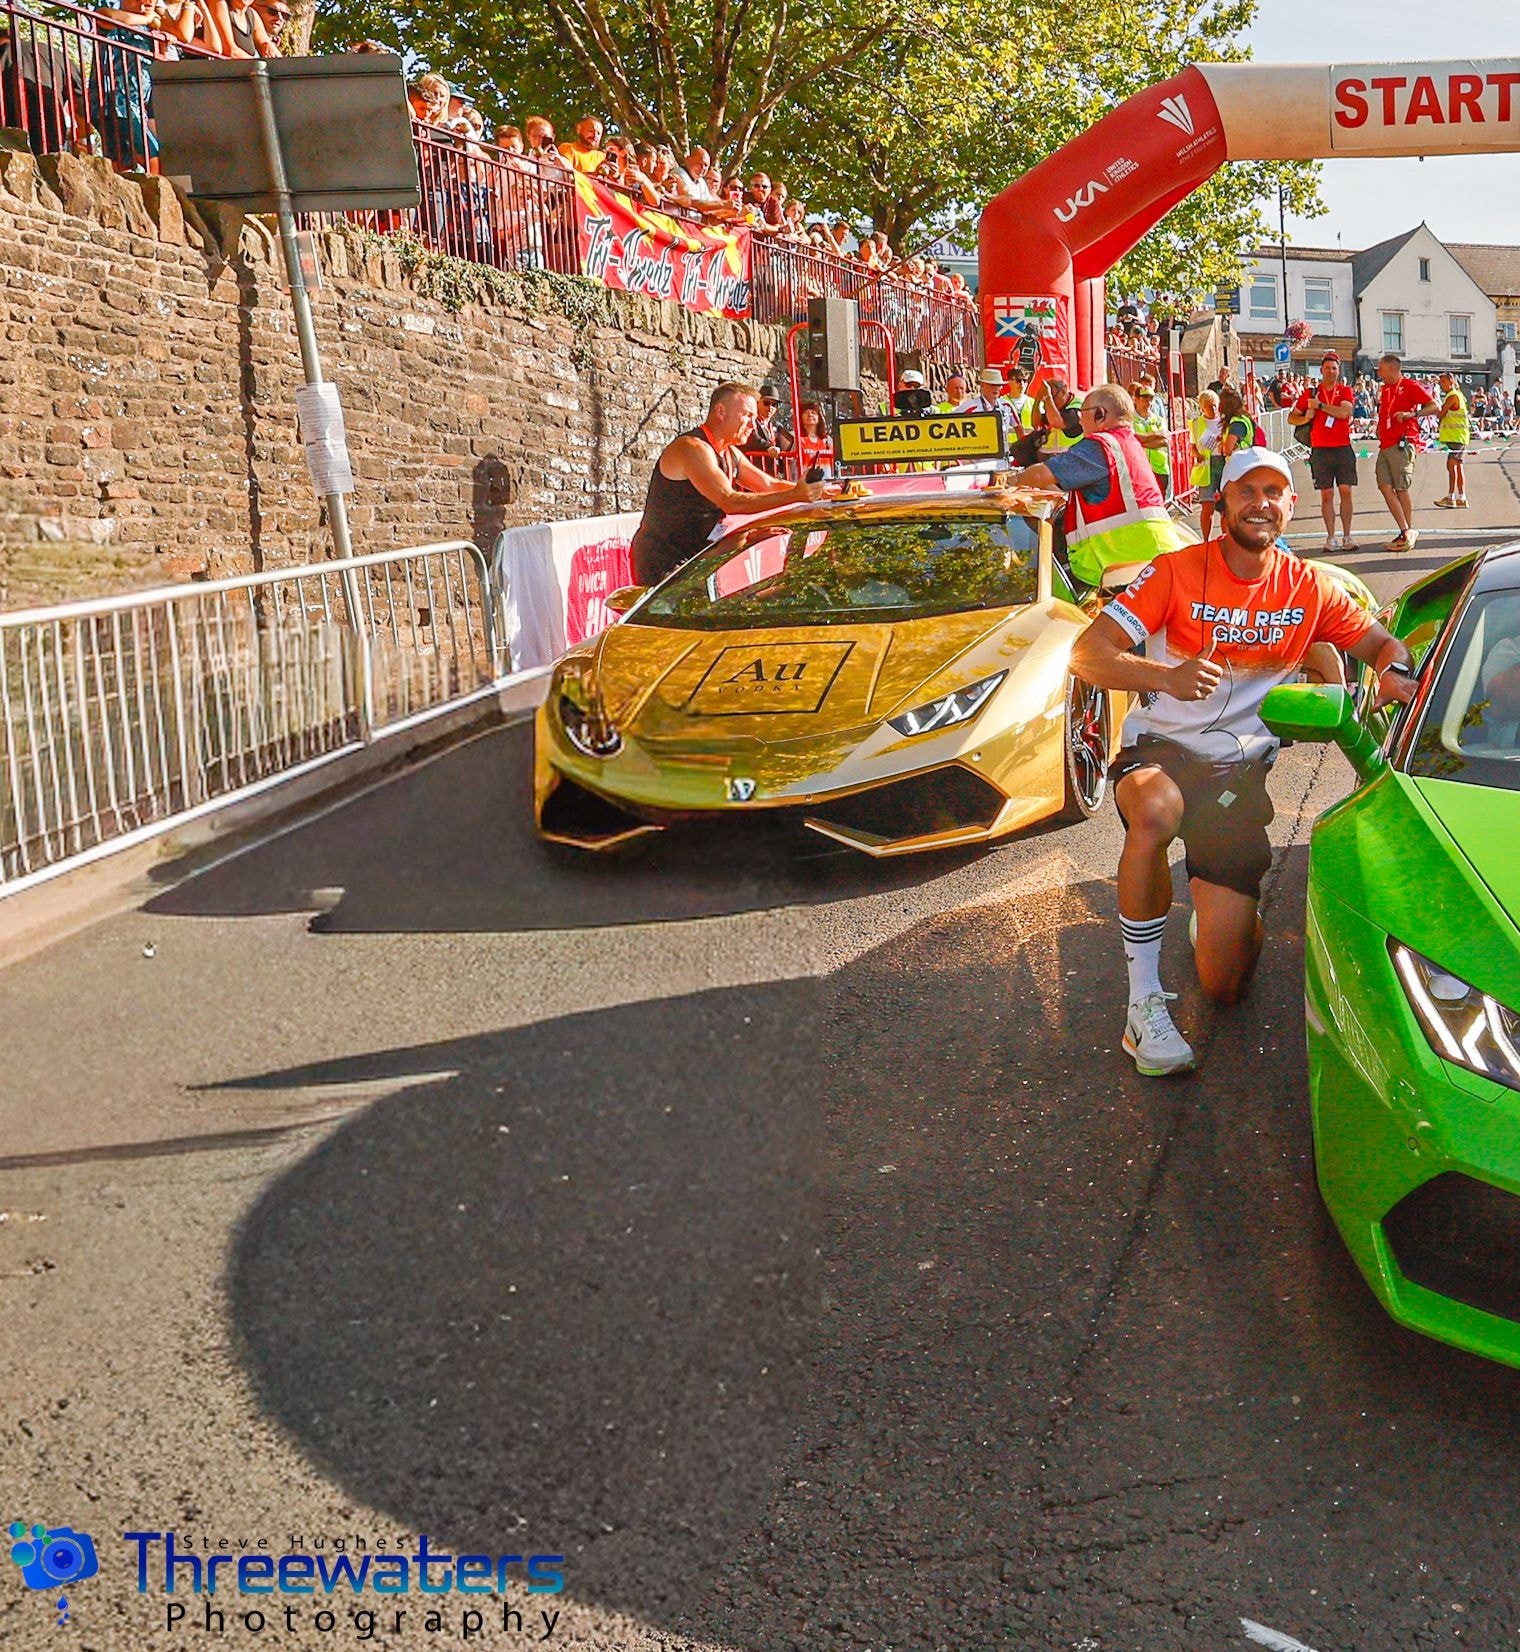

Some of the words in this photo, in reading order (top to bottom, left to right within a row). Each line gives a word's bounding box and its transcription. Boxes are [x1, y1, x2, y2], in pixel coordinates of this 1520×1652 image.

[1106, 157, 1126, 174] UNITED
[1113, 161, 1140, 183] ATHLETICS
[1053, 180, 1110, 223] UKA
[859, 425, 921, 443] LEAD
[928, 421, 978, 439] CAR
[1113, 603, 1129, 618] ONE
[1126, 615, 1147, 638] GROUP
[1190, 601, 1249, 628] TEAM
[1254, 607, 1305, 628] REES
[1212, 624, 1286, 645] GROUP
[722, 658, 808, 684] Au
[718, 684, 801, 695] VODKA
